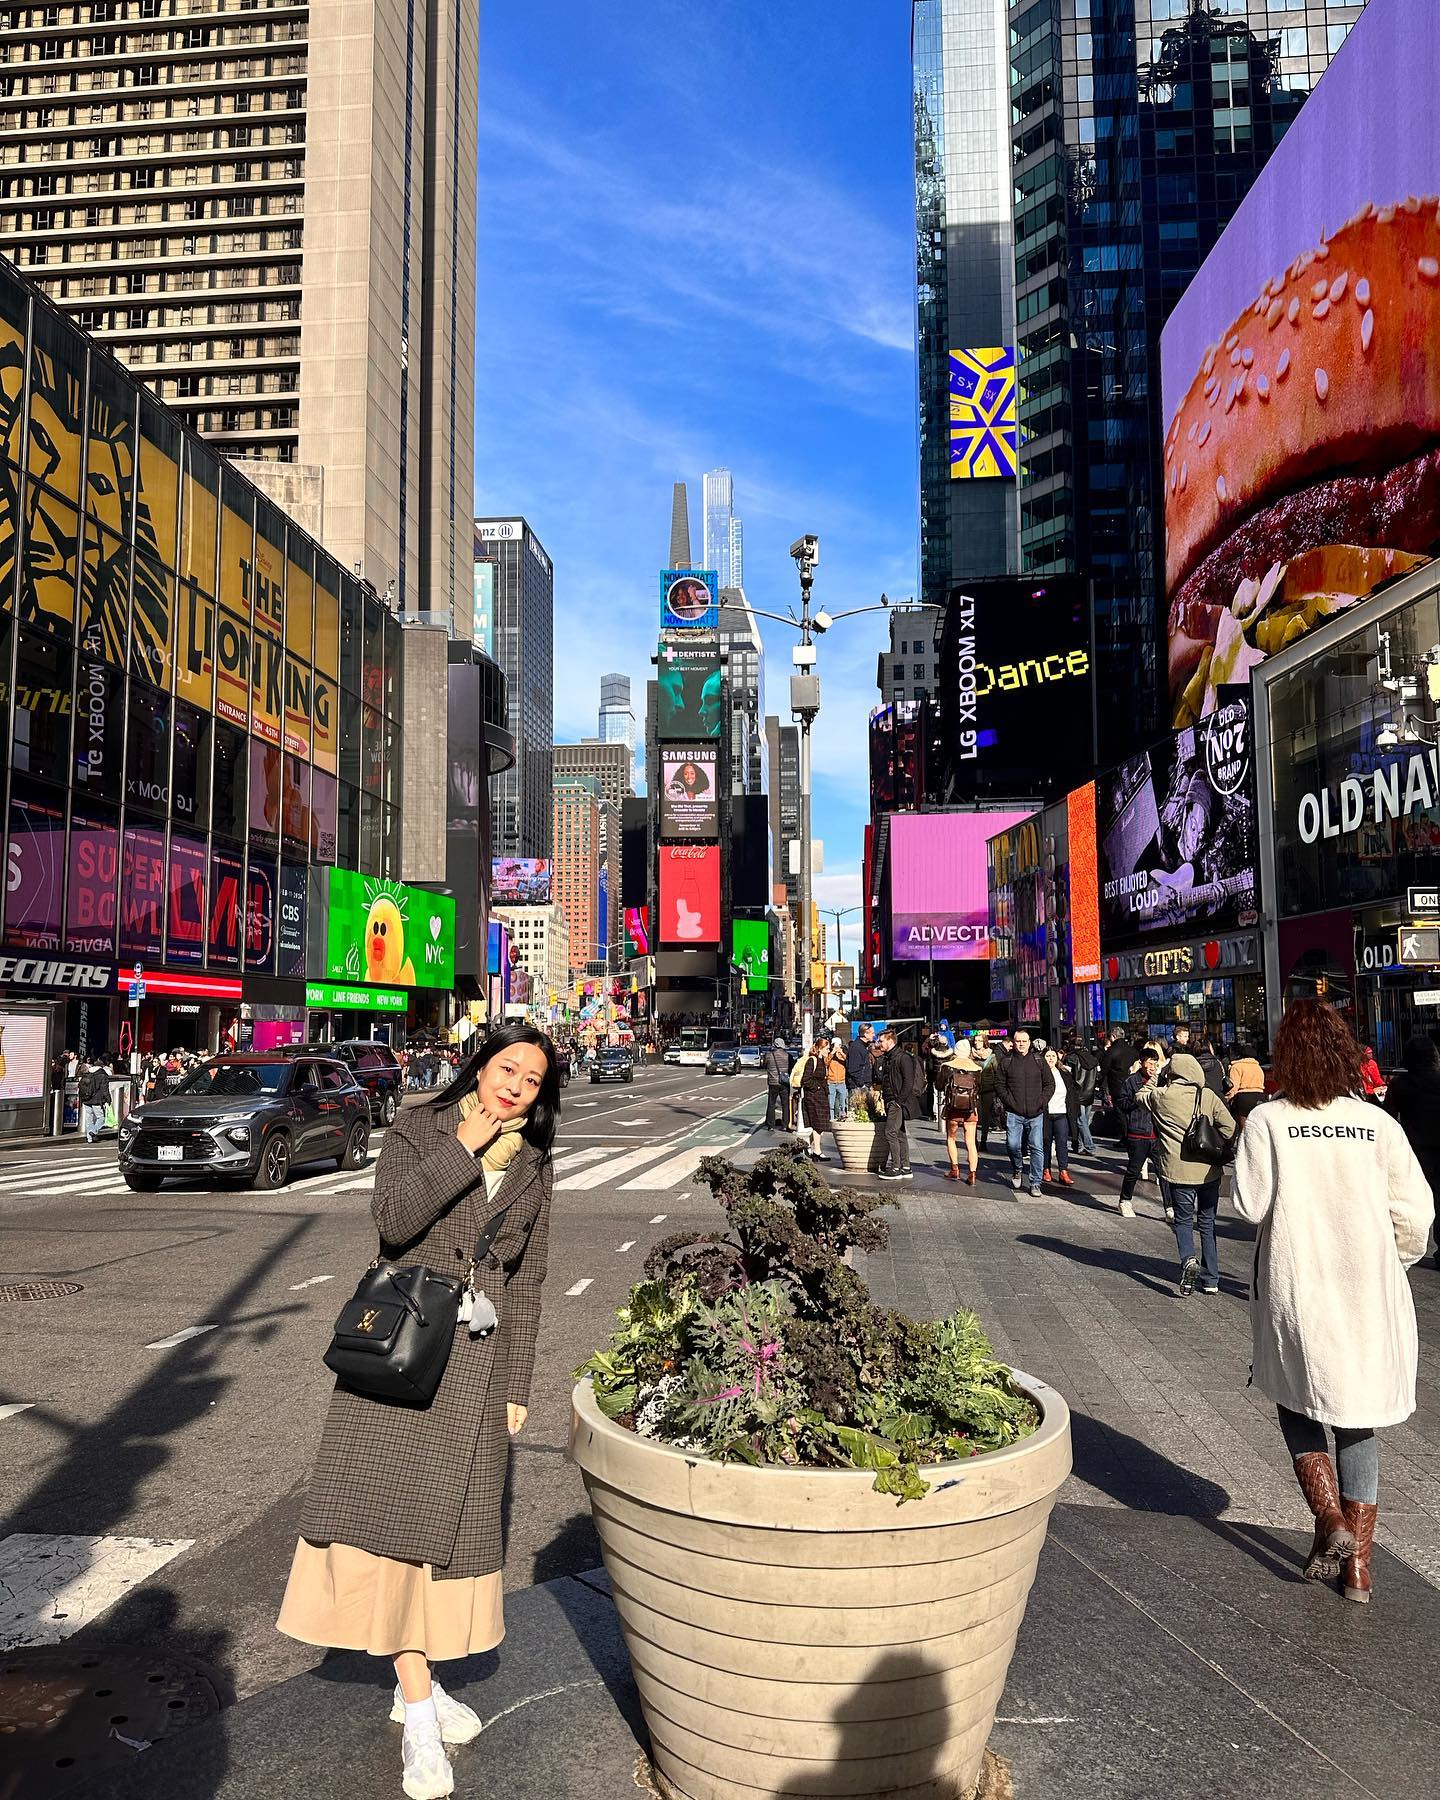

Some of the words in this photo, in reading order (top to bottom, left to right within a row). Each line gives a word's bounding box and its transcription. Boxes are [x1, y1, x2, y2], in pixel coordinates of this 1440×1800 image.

[239, 557, 282, 623] THE
[664, 573, 682, 582] NOW
[686, 573, 714, 581] WHAT?
[664, 615, 682, 625] NOW
[960, 595, 976, 631] XL7
[187, 573, 262, 688] LION
[265, 629, 329, 729] KING
[958, 635, 977, 723] XBOOM
[973, 649, 1090, 697] Dance
[218, 701, 247, 723] ENTRANCE
[253, 719, 263, 731] ON
[284, 733, 300, 751] STREET
[662, 750, 717, 761] SAMSUNG
[960, 729, 978, 760] LG
[1217, 759, 1241, 780] BRAND
[1298, 778, 1364, 844] OLD
[77, 839, 164, 893] SUPER
[1104, 880, 1119, 900] BEST
[1119, 869, 1148, 892] ENJOYED
[78, 887, 163, 937] BOWL
[282, 903, 300, 922] CBS
[1129, 890, 1159, 912] LOUD
[331, 965, 344, 974] SALLY
[425, 943, 445, 965] NYC
[1143, 946, 1194, 977] GIFTS
[1363, 944, 1393, 969] OLD
[332, 991, 346, 1003] LINE
[346, 992, 370, 1005] FRIENDS
[376, 995, 388, 1005] NEW
[389, 995, 403, 1006] YORK
[1287, 1125, 1375, 1142] DESCENTE
